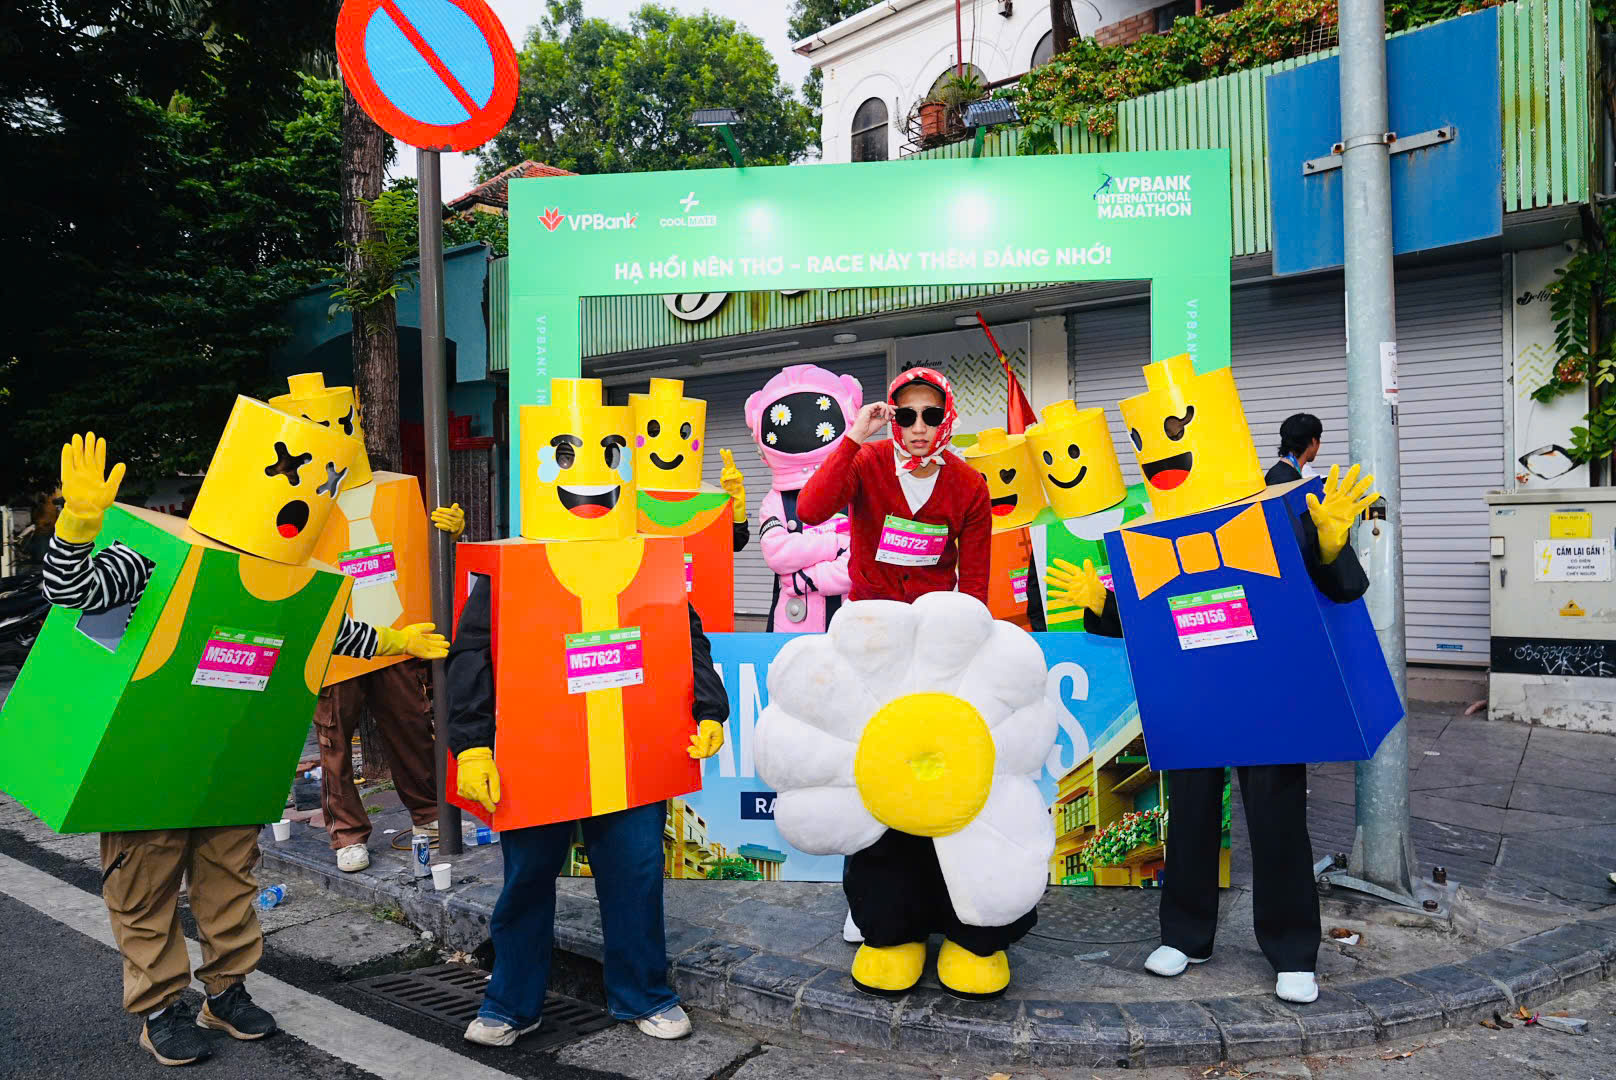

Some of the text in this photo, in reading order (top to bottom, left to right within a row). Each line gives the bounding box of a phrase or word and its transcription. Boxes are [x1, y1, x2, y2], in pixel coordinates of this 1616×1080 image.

[1115, 175, 1192, 192] VPBANK
[1098, 192, 1192, 204] INTERNATIONAL
[1098, 203, 1192, 219] MARATHON
[568, 212, 637, 231] VPBank
[615, 261, 645, 285] HẠ
[693, 255, 735, 278] NÊN
[807, 255, 864, 273] RACE
[869, 249, 913, 272] NÀY
[536, 315, 547, 376] VPBANK
[884, 532, 928, 550] M56722
[1176, 608, 1227, 629] M59156
[205, 646, 256, 666] M56378
[569, 649, 620, 670] M57623
